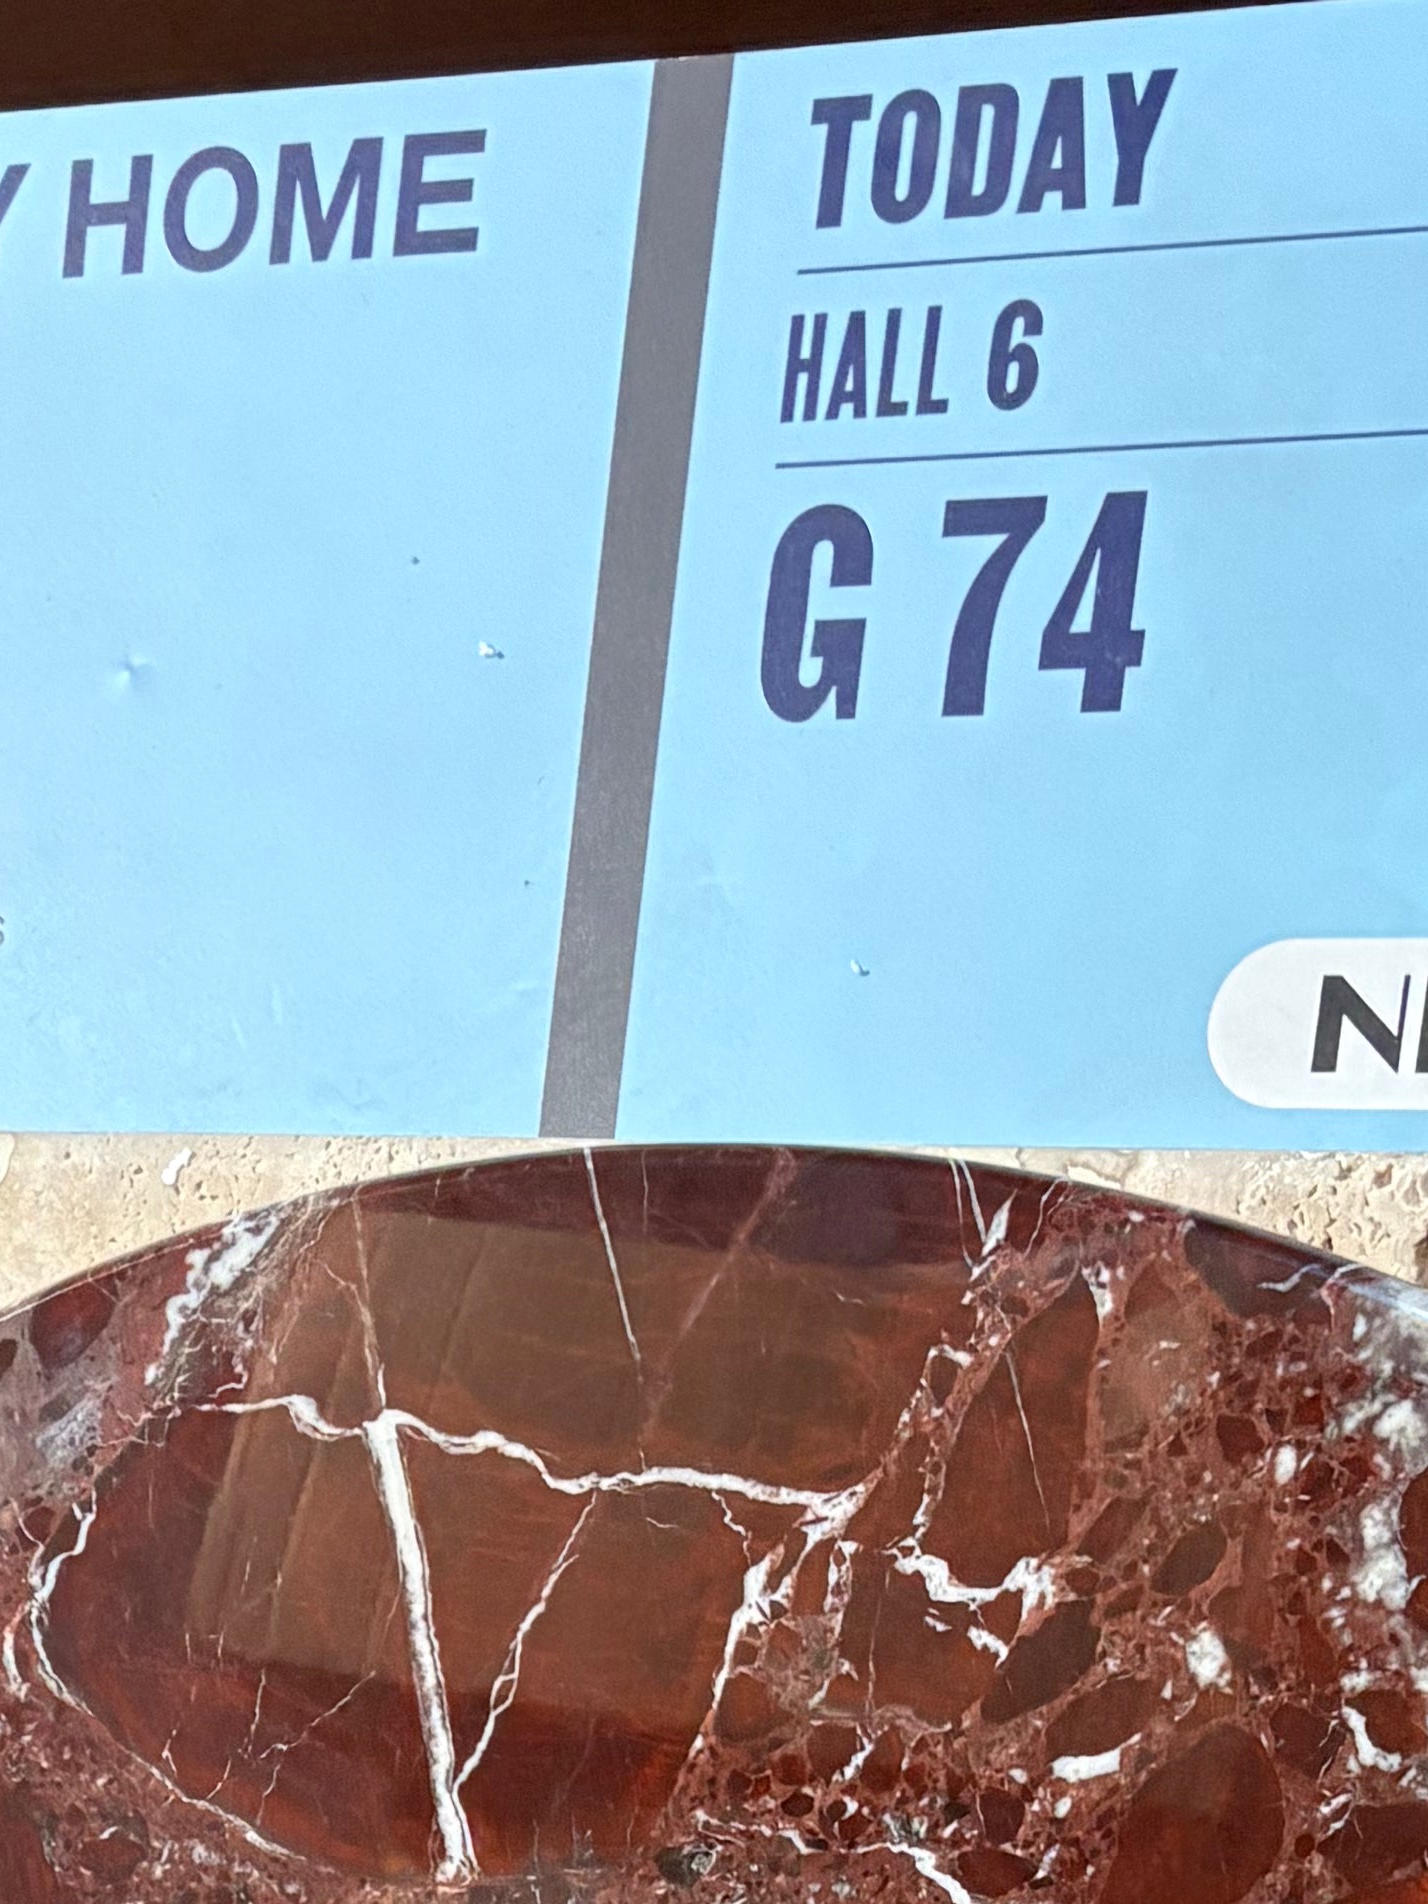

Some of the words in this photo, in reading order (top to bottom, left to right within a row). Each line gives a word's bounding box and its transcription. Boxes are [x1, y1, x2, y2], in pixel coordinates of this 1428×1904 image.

[62, 129, 488, 279] HOME
[810, 67, 1178, 230] TODAY
[779, 305, 950, 424] HALL
[987, 298, 1044, 412] 6
[760, 503, 874, 724] G
[940, 490, 1150, 718] 74
